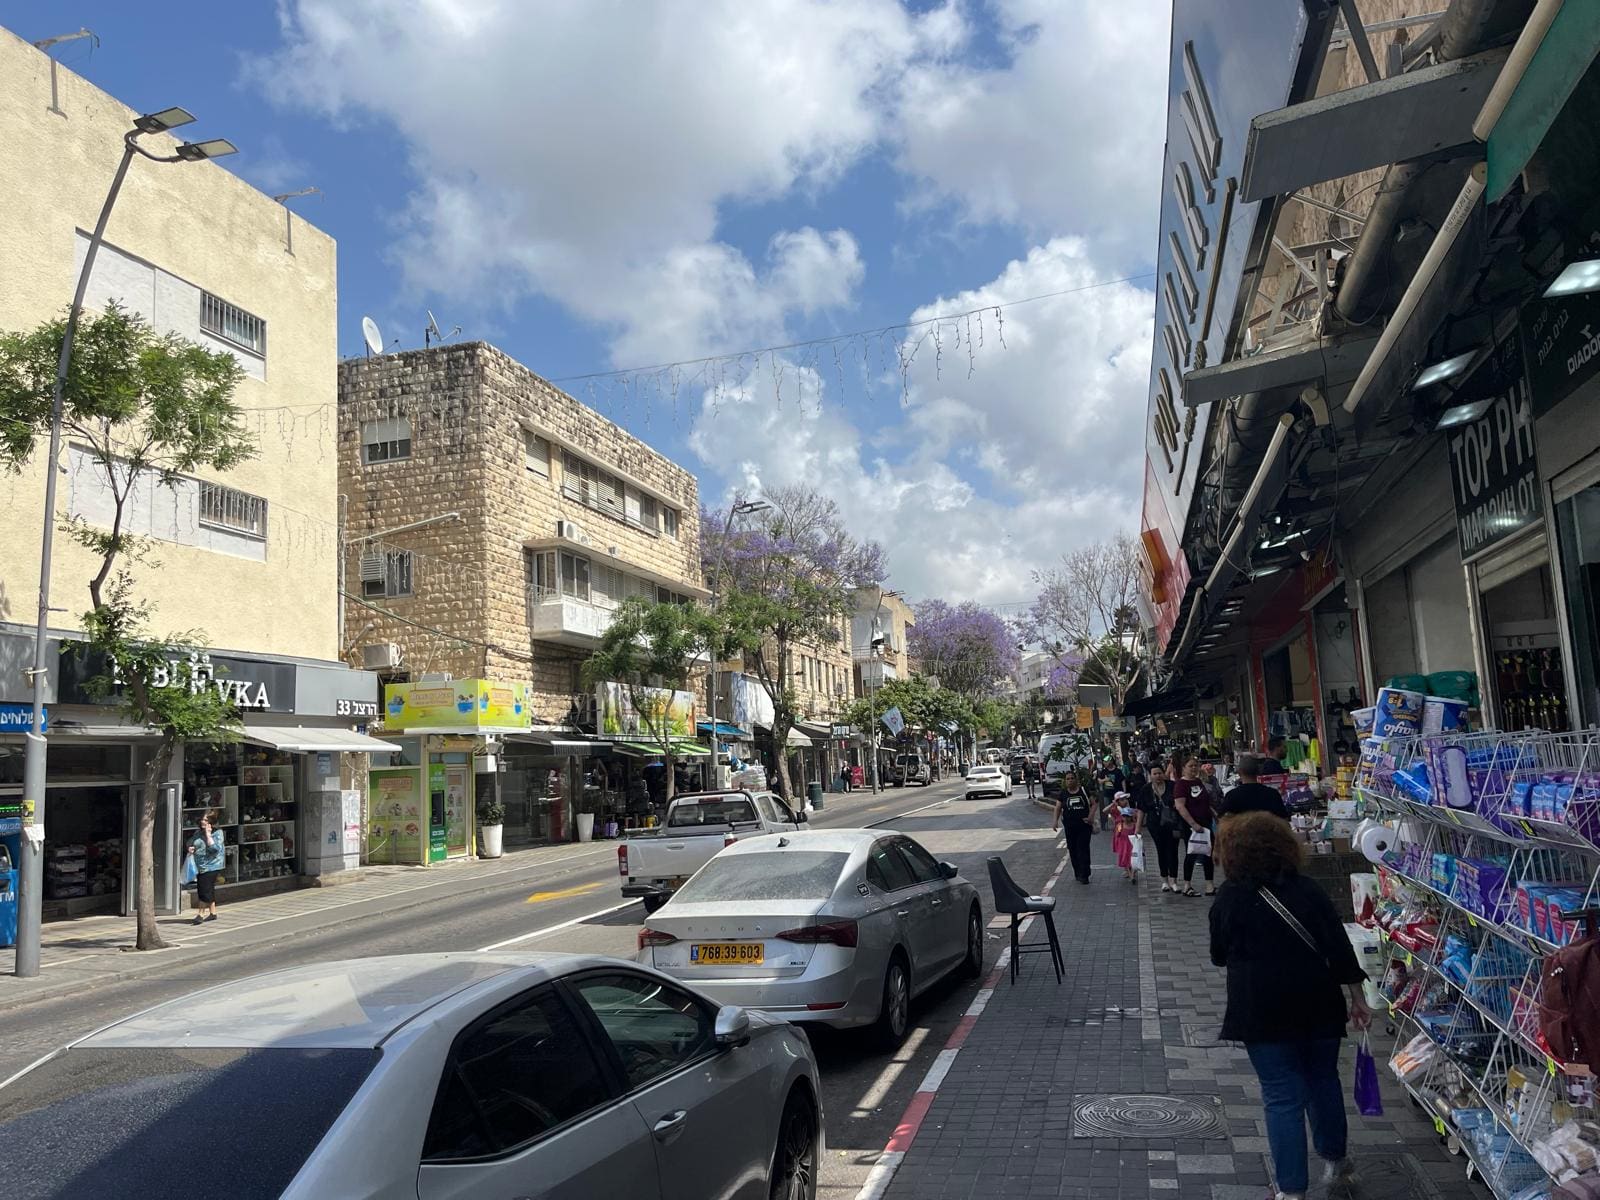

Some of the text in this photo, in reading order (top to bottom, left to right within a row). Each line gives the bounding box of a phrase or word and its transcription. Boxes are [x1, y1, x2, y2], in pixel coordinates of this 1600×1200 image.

[1452, 419, 1493, 505] TOP
[1461, 486, 1517, 551] МАГАЗИН
[337, 700, 377, 716] הרצל 33
